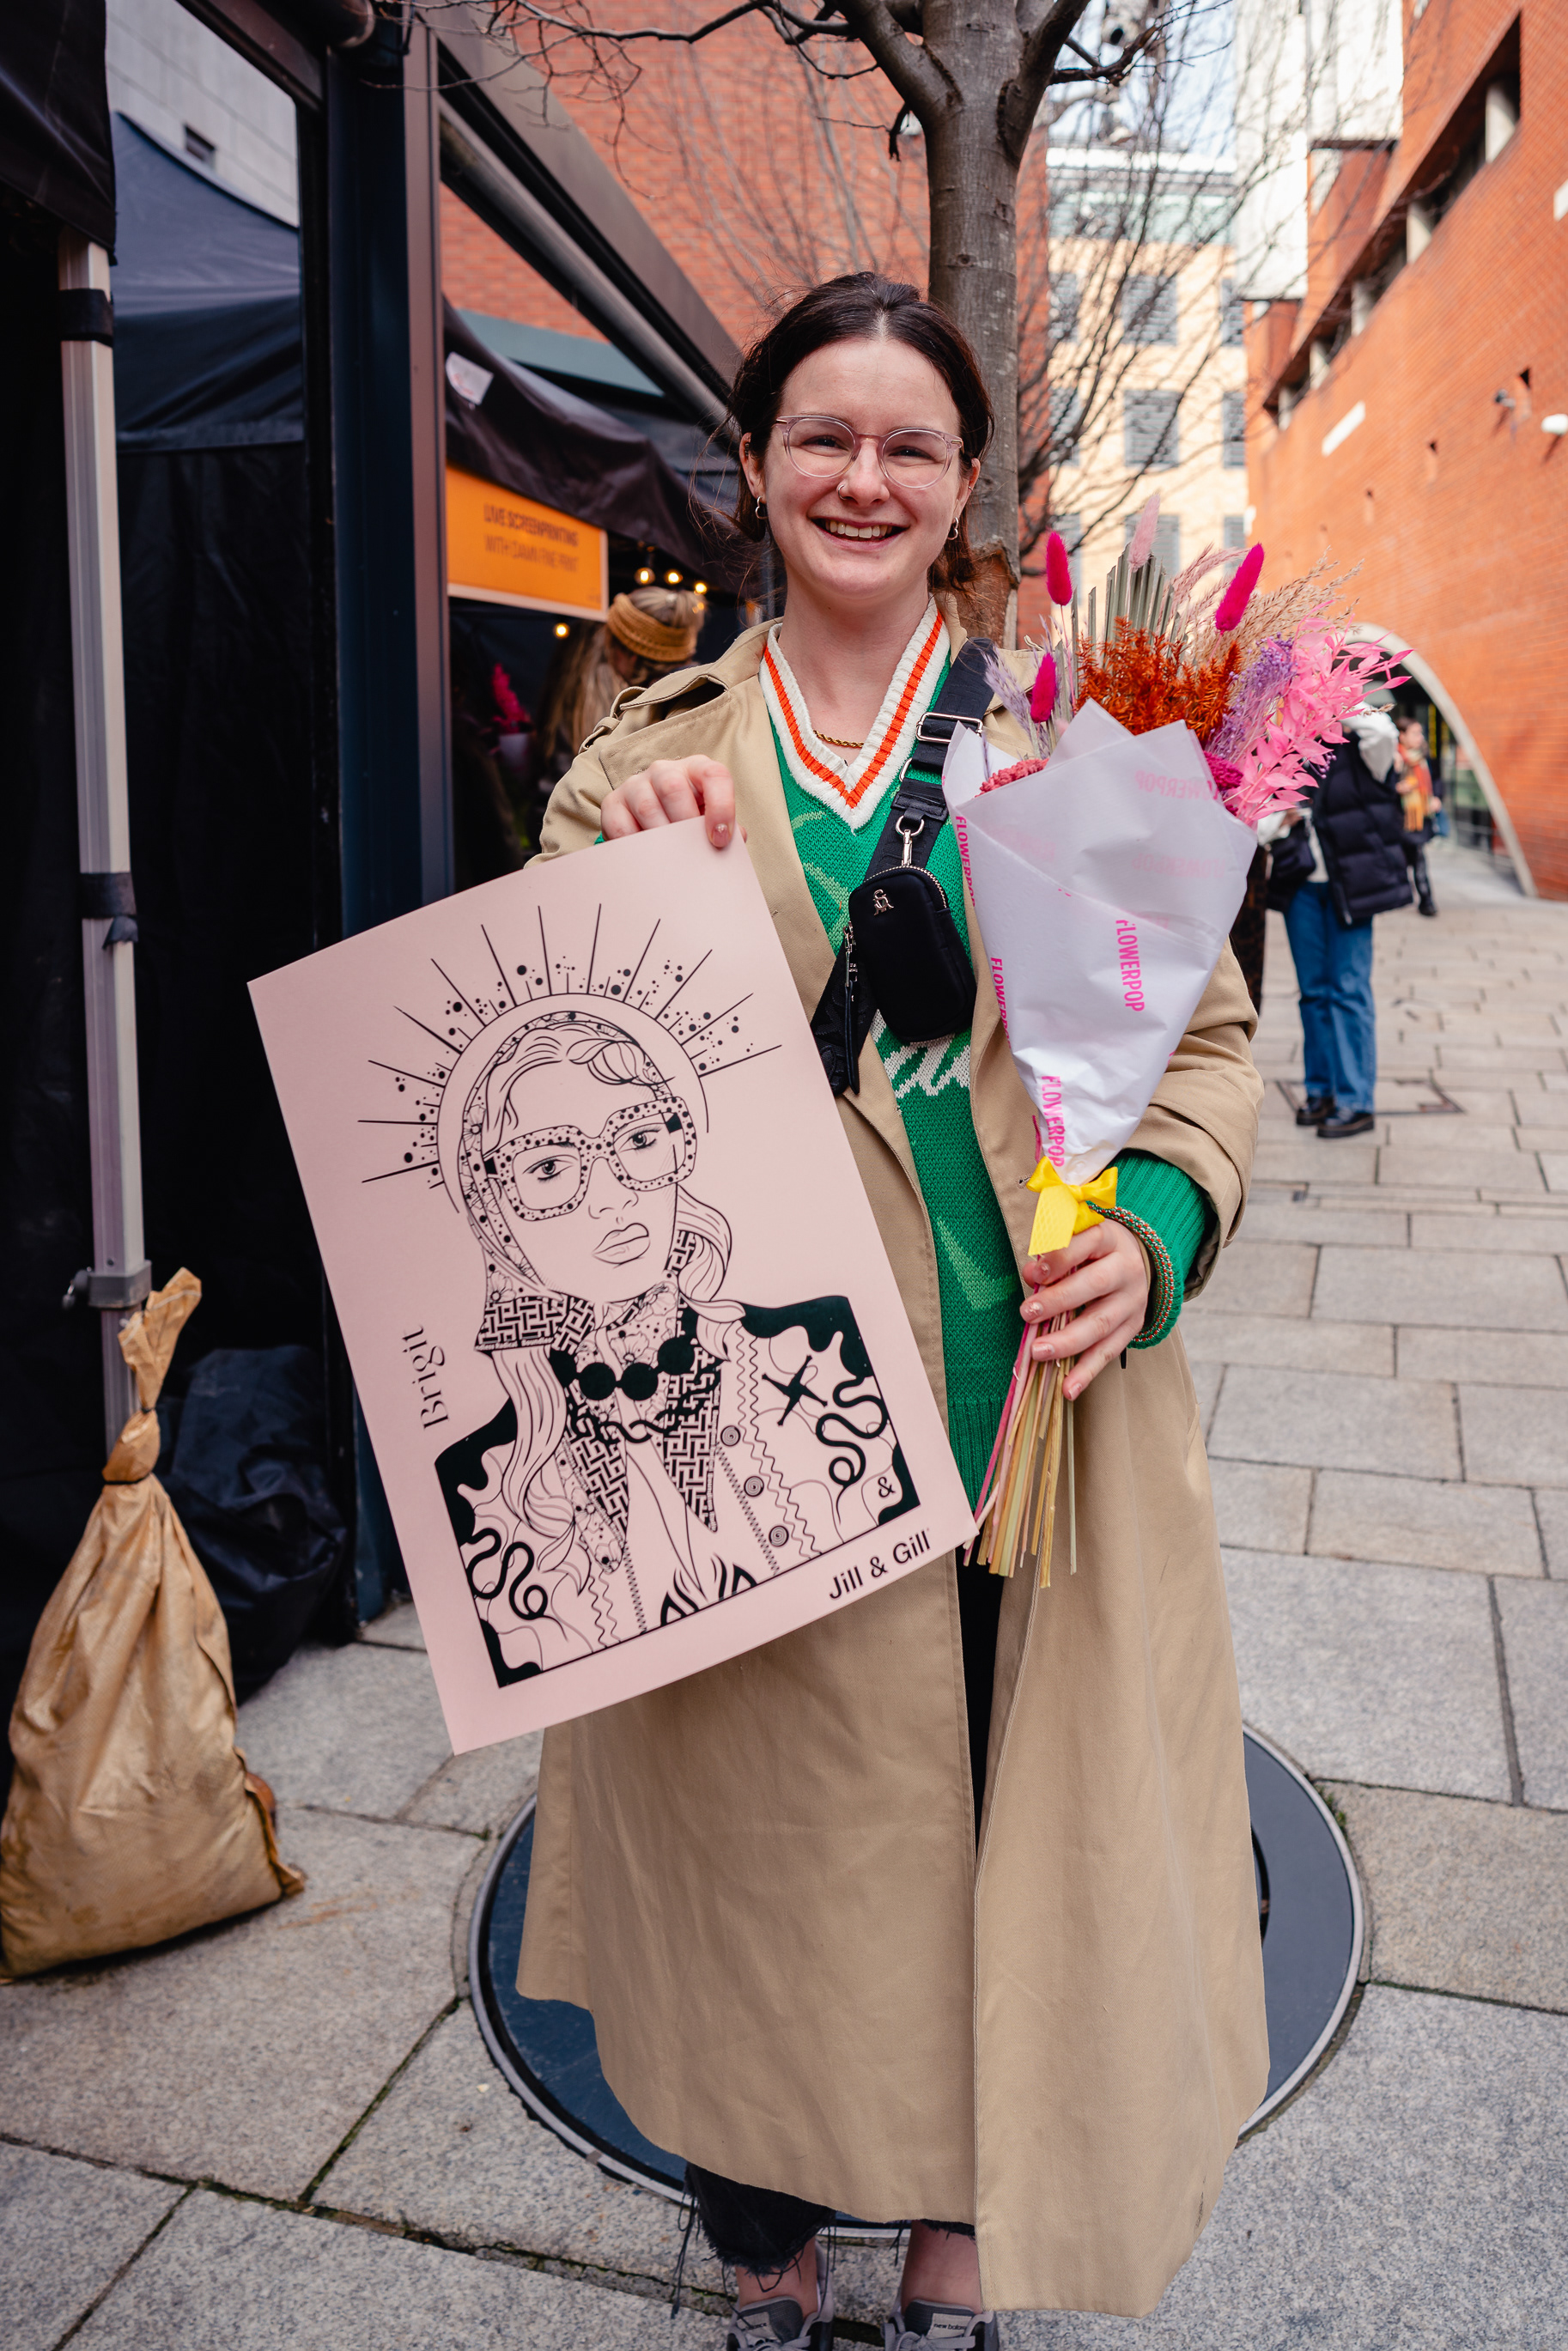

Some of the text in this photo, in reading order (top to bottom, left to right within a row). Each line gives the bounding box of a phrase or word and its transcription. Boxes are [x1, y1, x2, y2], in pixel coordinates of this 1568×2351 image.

[483, 503, 579, 548] LIVE SCREENPRINTING
[1115, 919, 1146, 1011] FLOWERPOP
[1041, 1075, 1066, 1167] FLOWERPOP
[402, 1323, 450, 1430] Brigit
[878, 1476, 896, 1497] &
[830, 1529, 931, 1599] Jill & Gill
